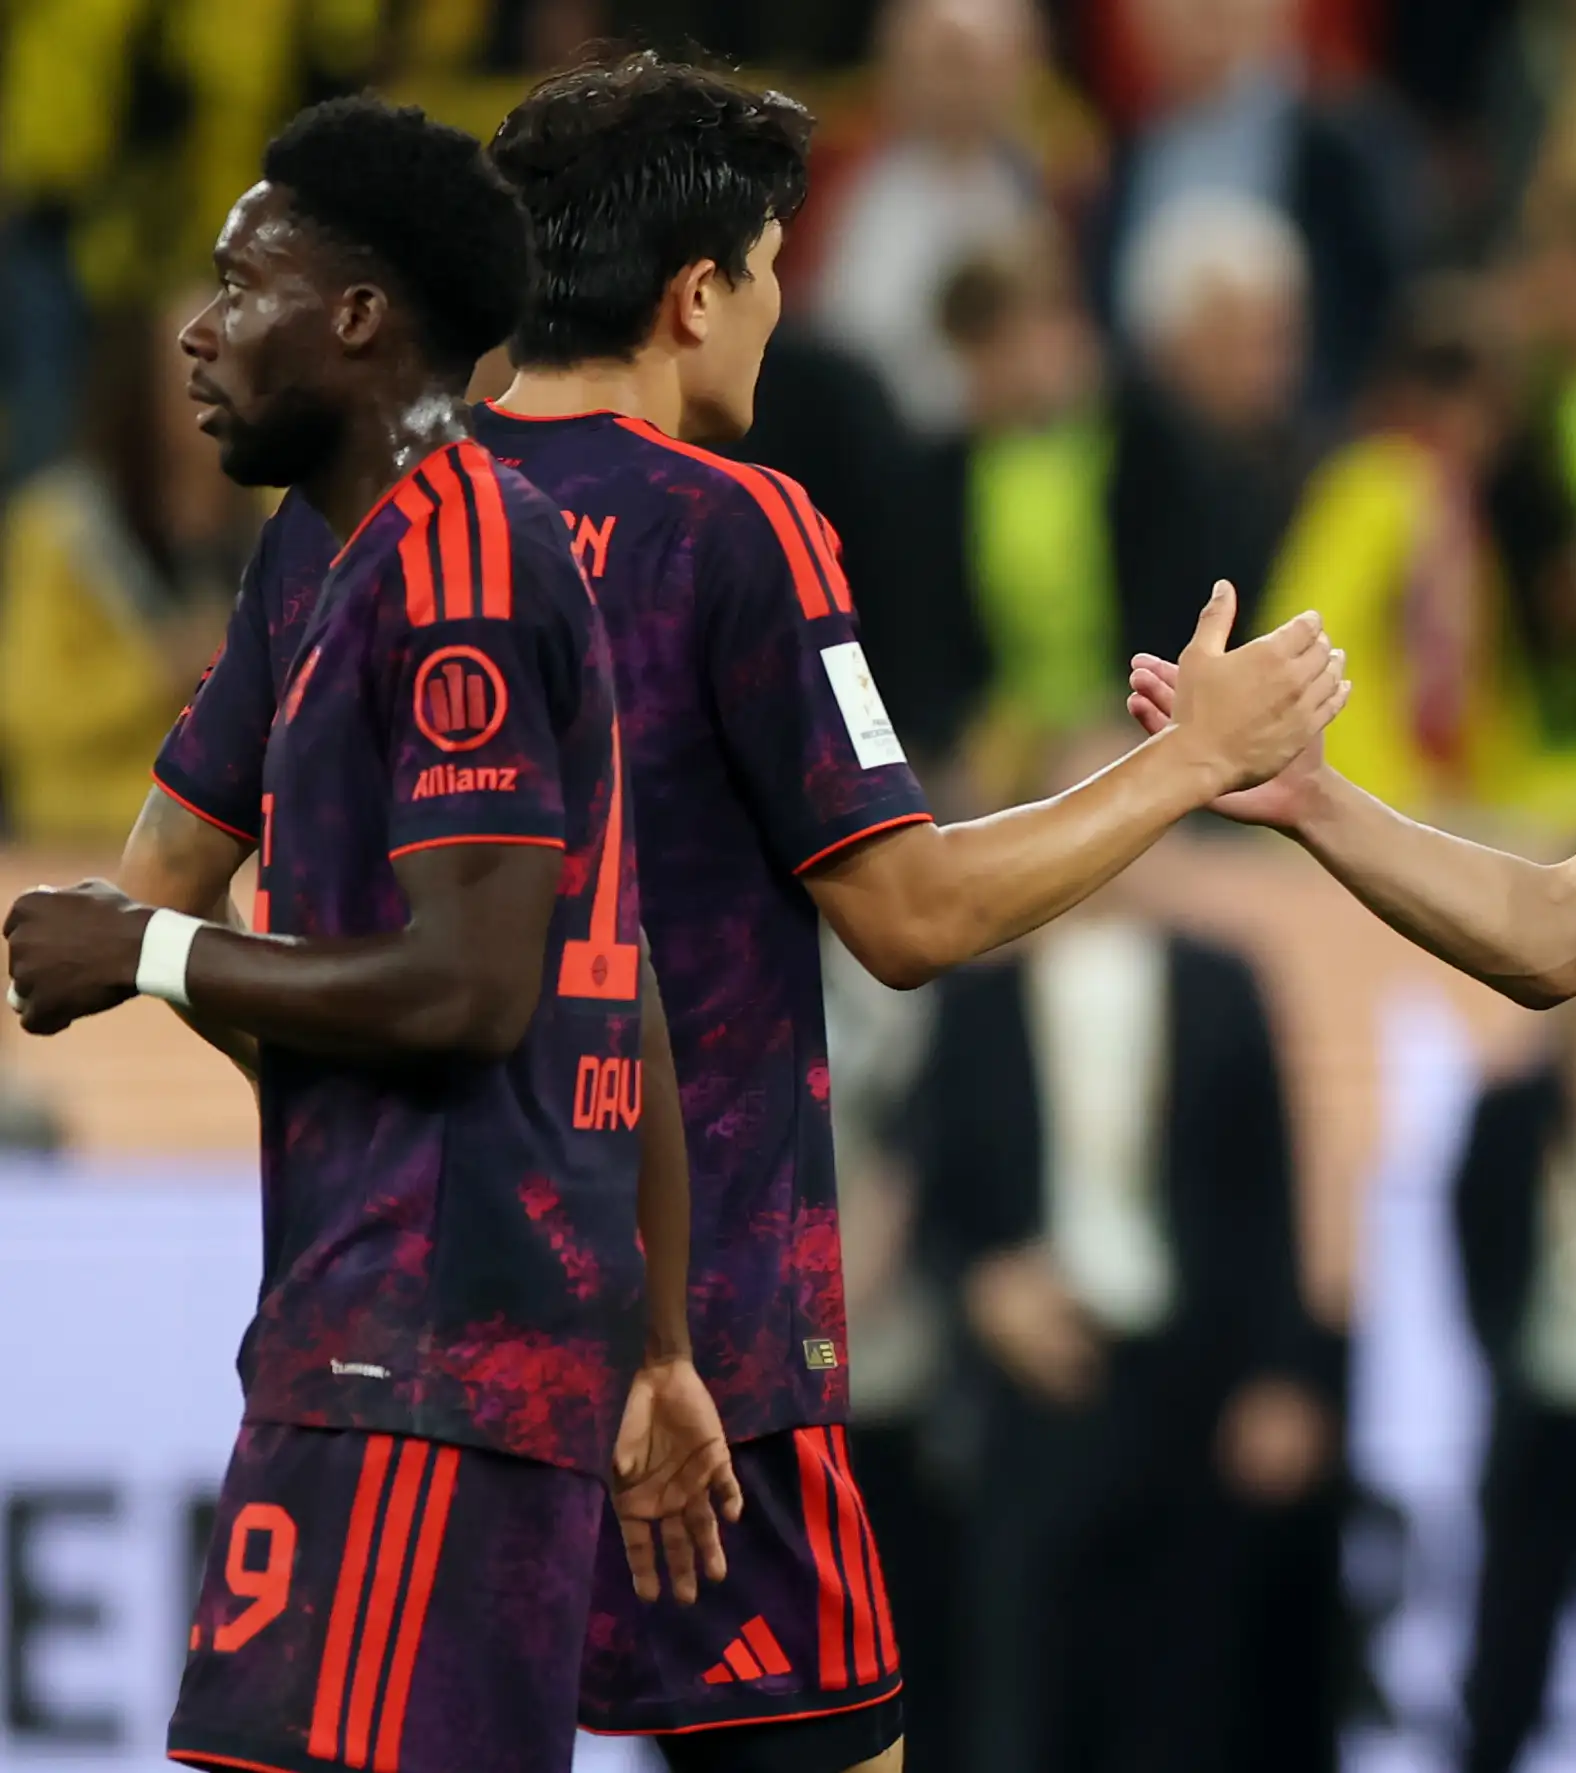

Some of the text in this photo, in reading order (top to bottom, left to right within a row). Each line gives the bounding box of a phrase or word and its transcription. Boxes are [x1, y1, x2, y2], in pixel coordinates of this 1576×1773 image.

[559, 509, 617, 578] N
[411, 764, 519, 801] Allianz
[572, 1054, 643, 1131] DAV
[190, 1502, 297, 1653] 9
